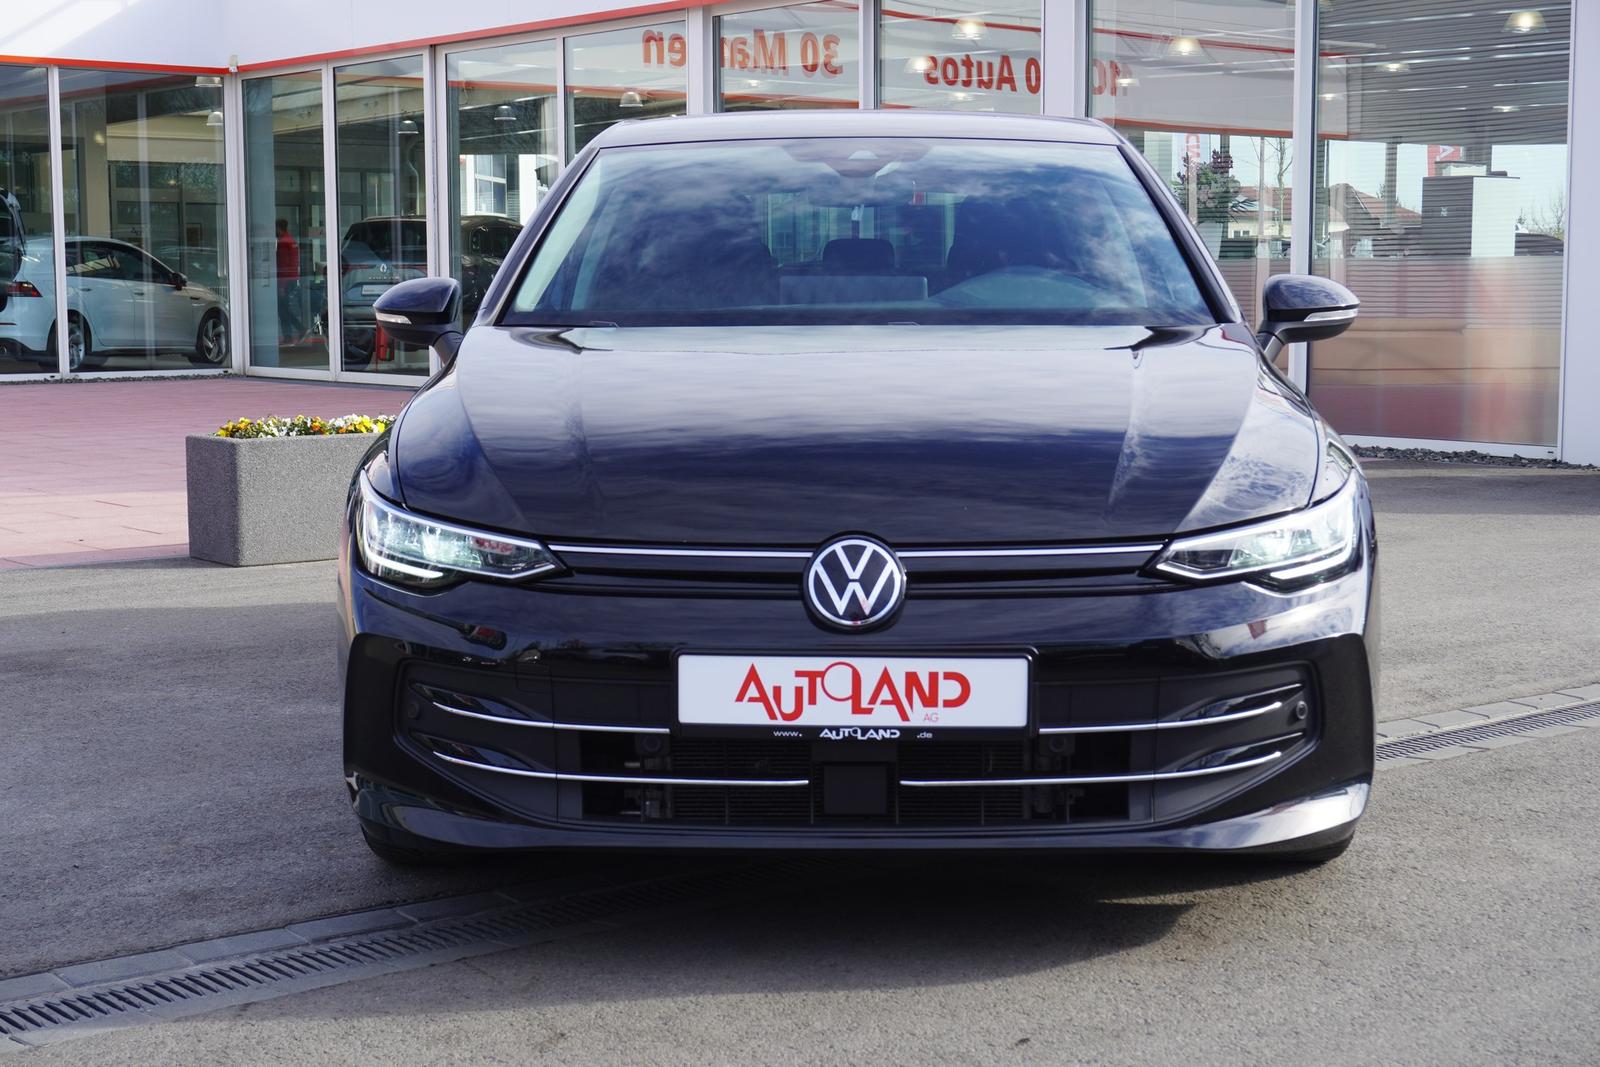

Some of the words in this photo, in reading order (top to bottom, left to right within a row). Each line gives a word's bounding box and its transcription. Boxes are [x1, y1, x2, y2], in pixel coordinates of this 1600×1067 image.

[735, 661, 972, 722] AUTOLAND
[923, 712, 940, 722] AG
[773, 730, 802, 738] www.
[819, 727, 900, 740] AUTOLAND
[916, 731, 933, 739] .de
